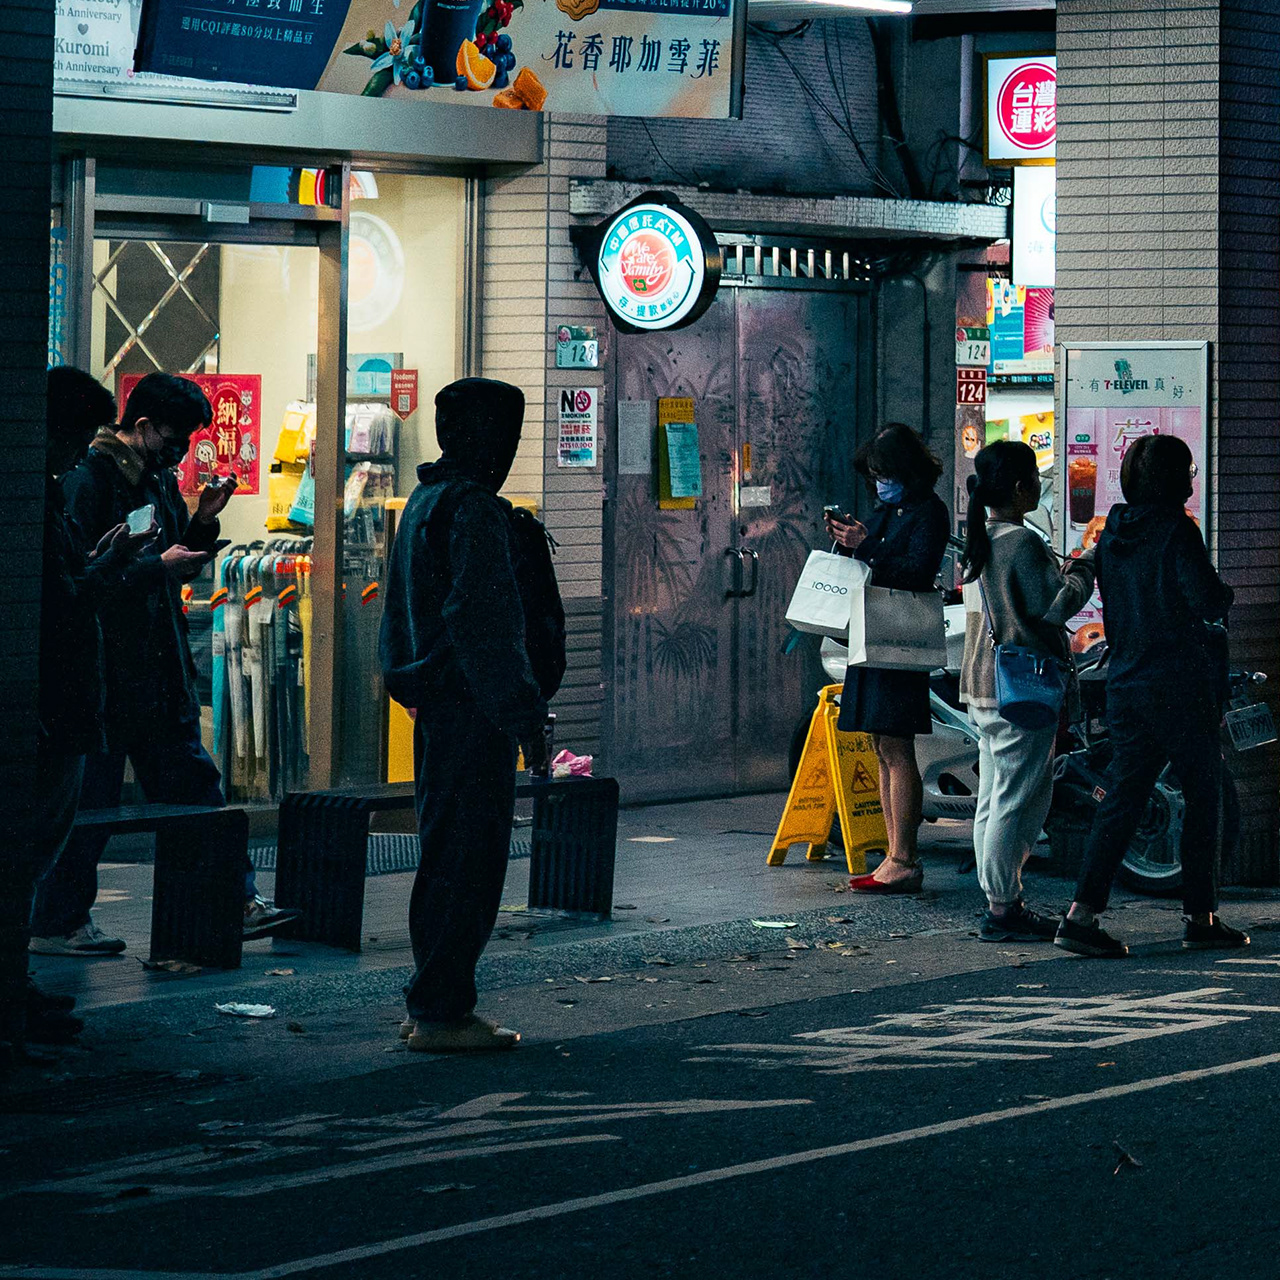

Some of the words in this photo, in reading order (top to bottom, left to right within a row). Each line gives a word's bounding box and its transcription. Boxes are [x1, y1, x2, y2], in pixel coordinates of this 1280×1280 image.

[66, 7, 122, 23] Anniversary
[54, 37, 109, 58] Kuromi
[541, 30, 721, 79] 花香耶加雪菲
[65, 61, 122, 77] Anniversary
[1012, 80, 1056, 107] 台灣
[1010, 107, 1056, 134] 運彩
[610, 214, 685, 252] 中國信託ATM
[968, 344, 987, 360] 124
[960, 383, 984, 401] 124
[1089, 378, 1100, 393] 有
[1154, 377, 1166, 391] 真
[1172, 384, 1185, 399] 好
[216, 396, 241, 456] 納福
